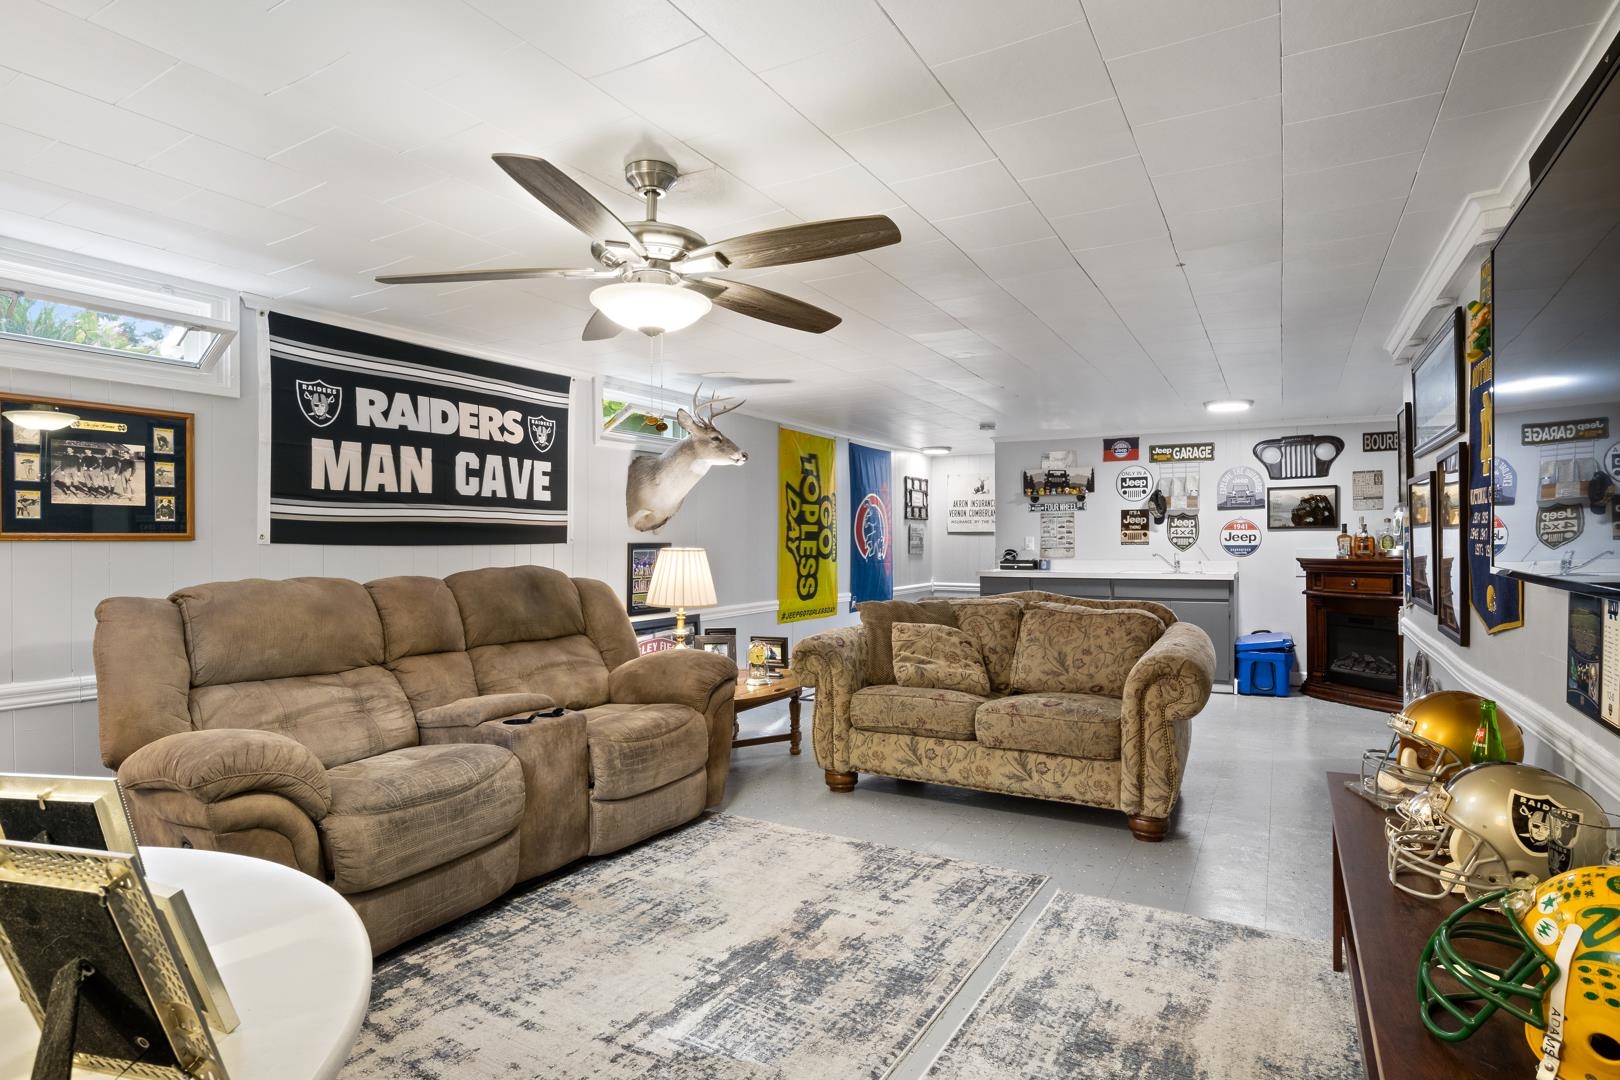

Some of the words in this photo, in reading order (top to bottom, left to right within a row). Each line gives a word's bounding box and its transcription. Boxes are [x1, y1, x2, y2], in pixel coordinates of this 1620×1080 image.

[302, 383, 337, 395] RAIDERS
[355, 386, 524, 445] RAIDERS
[531, 418, 553, 427] RAIDERS
[1152, 447, 1172, 456] Jeep
[1173, 445, 1212, 459] GARAGE
[311, 437, 433, 494] MAN
[455, 451, 552, 502] CAVE
[1122, 478, 1147, 488] Jeep
[953, 499, 969, 508] AKRON
[1044, 502, 1058, 512] FOUR
[1059, 502, 1078, 512] WHEEL
[949, 509, 967, 518] VERNON
[787, 485, 800, 562] DAY
[799, 456, 820, 597] TOPLESS
[1122, 515, 1147, 526] Jeep
[1171, 518, 1195, 528] Jeep
[818, 499, 833, 555] GO
[1224, 532, 1257, 544] Jeep
[641, 641, 658, 655] LEY
[1543, 1006, 1562, 1062] ADAMS
